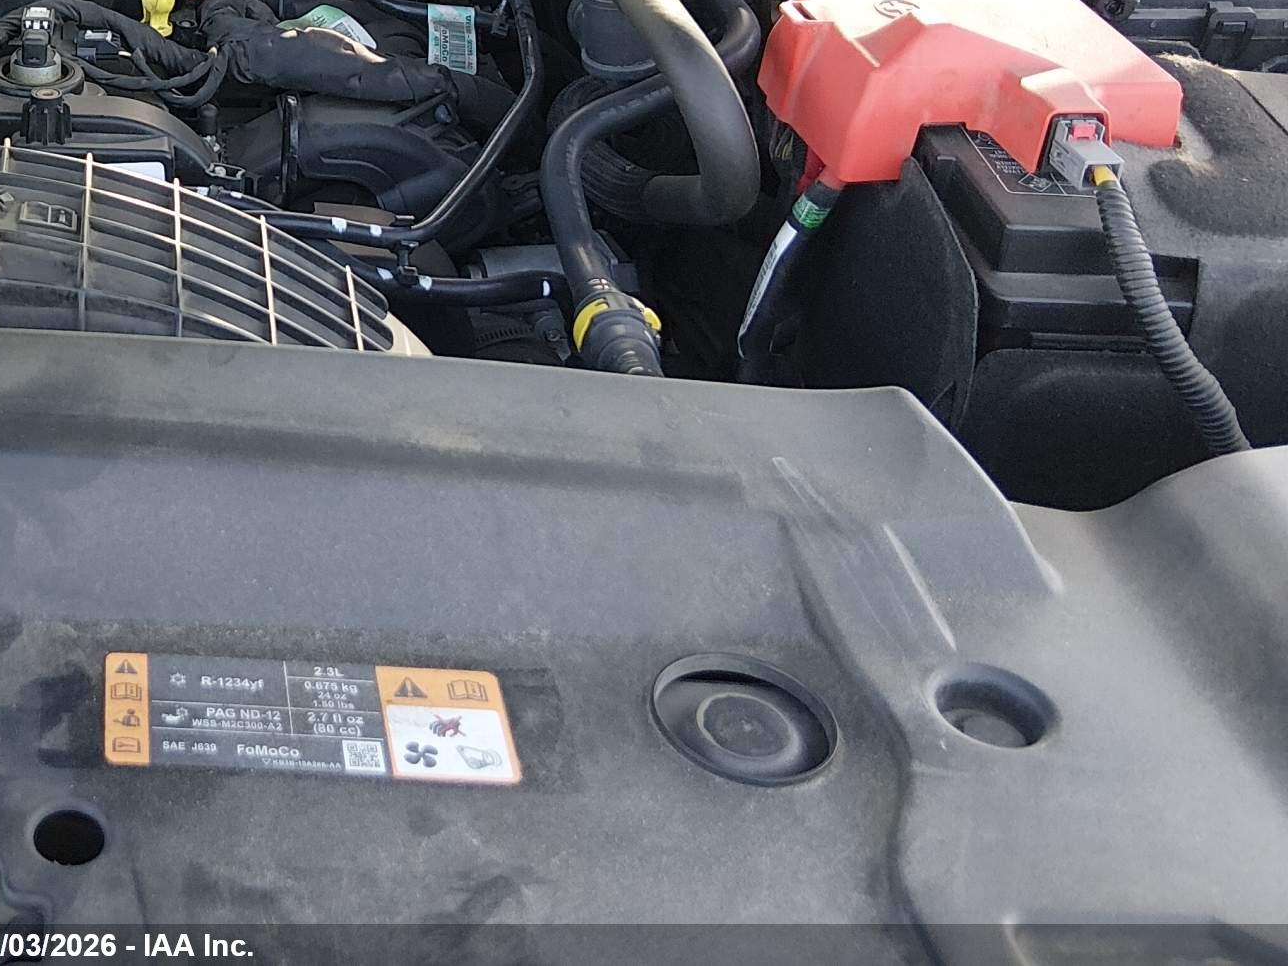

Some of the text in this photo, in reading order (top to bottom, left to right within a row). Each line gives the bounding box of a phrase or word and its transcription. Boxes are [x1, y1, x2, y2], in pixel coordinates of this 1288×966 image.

[313, 666, 344, 677] 2.3L
[200, 675, 264, 691] R-1234yf
[341, 682, 358, 694] kg
[337, 700, 355, 709] lbs
[206, 707, 281, 721] PAG ND-12
[306, 711, 328, 723] 2.7
[346, 716, 364, 725] oz
[313, 723, 362, 737] (80 cc)
[162, 741, 217, 753] SAE J639
[236, 744, 300, 758] FoMoCo
